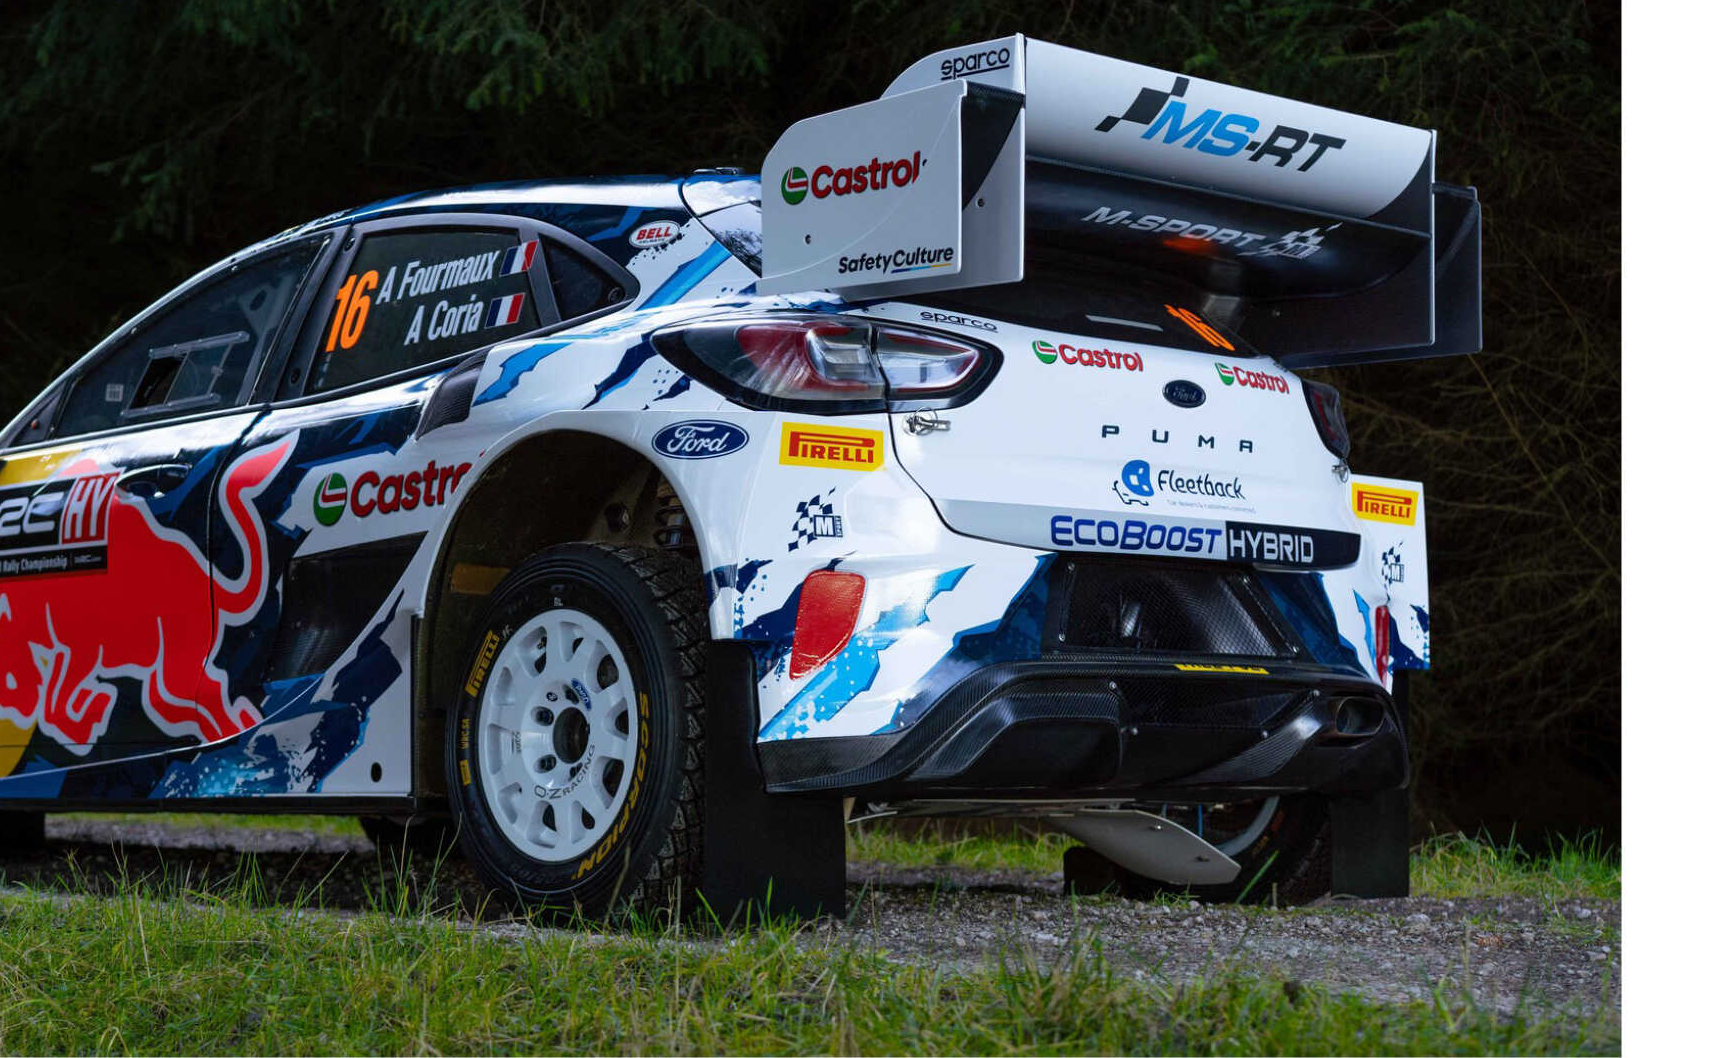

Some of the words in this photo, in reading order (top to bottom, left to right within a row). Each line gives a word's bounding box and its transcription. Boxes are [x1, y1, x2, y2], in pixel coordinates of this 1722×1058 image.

[939, 47, 1011, 80] sparco
[1140, 100, 1348, 173] MS-RT
[810, 150, 921, 199] Castrol
[636, 226, 673, 241] BELL
[1081, 206, 1267, 247] M-SPORT
[838, 246, 955, 274] SafetyCulture
[375, 266, 395, 305] A
[399, 250, 502, 300] Fourmaux
[324, 269, 379, 354] 16
[403, 306, 425, 347] A
[426, 293, 486, 340] Coria
[920, 311, 998, 332] sparco
[1058, 343, 1144, 372] Castrol
[1232, 365, 1290, 394] Castrol
[666, 424, 728, 454] Ford
[787, 430, 876, 464] PIRELLI
[1100, 424, 1254, 454] PUMA
[1157, 469, 1247, 500] Fleetback
[65, 475, 119, 540] HY
[1356, 489, 1413, 519] PIRELLI
[1228, 528, 1314, 564] HYBRID
[464, 629, 500, 699] PIRELLI
[573, 692, 650, 880] SCORPION
